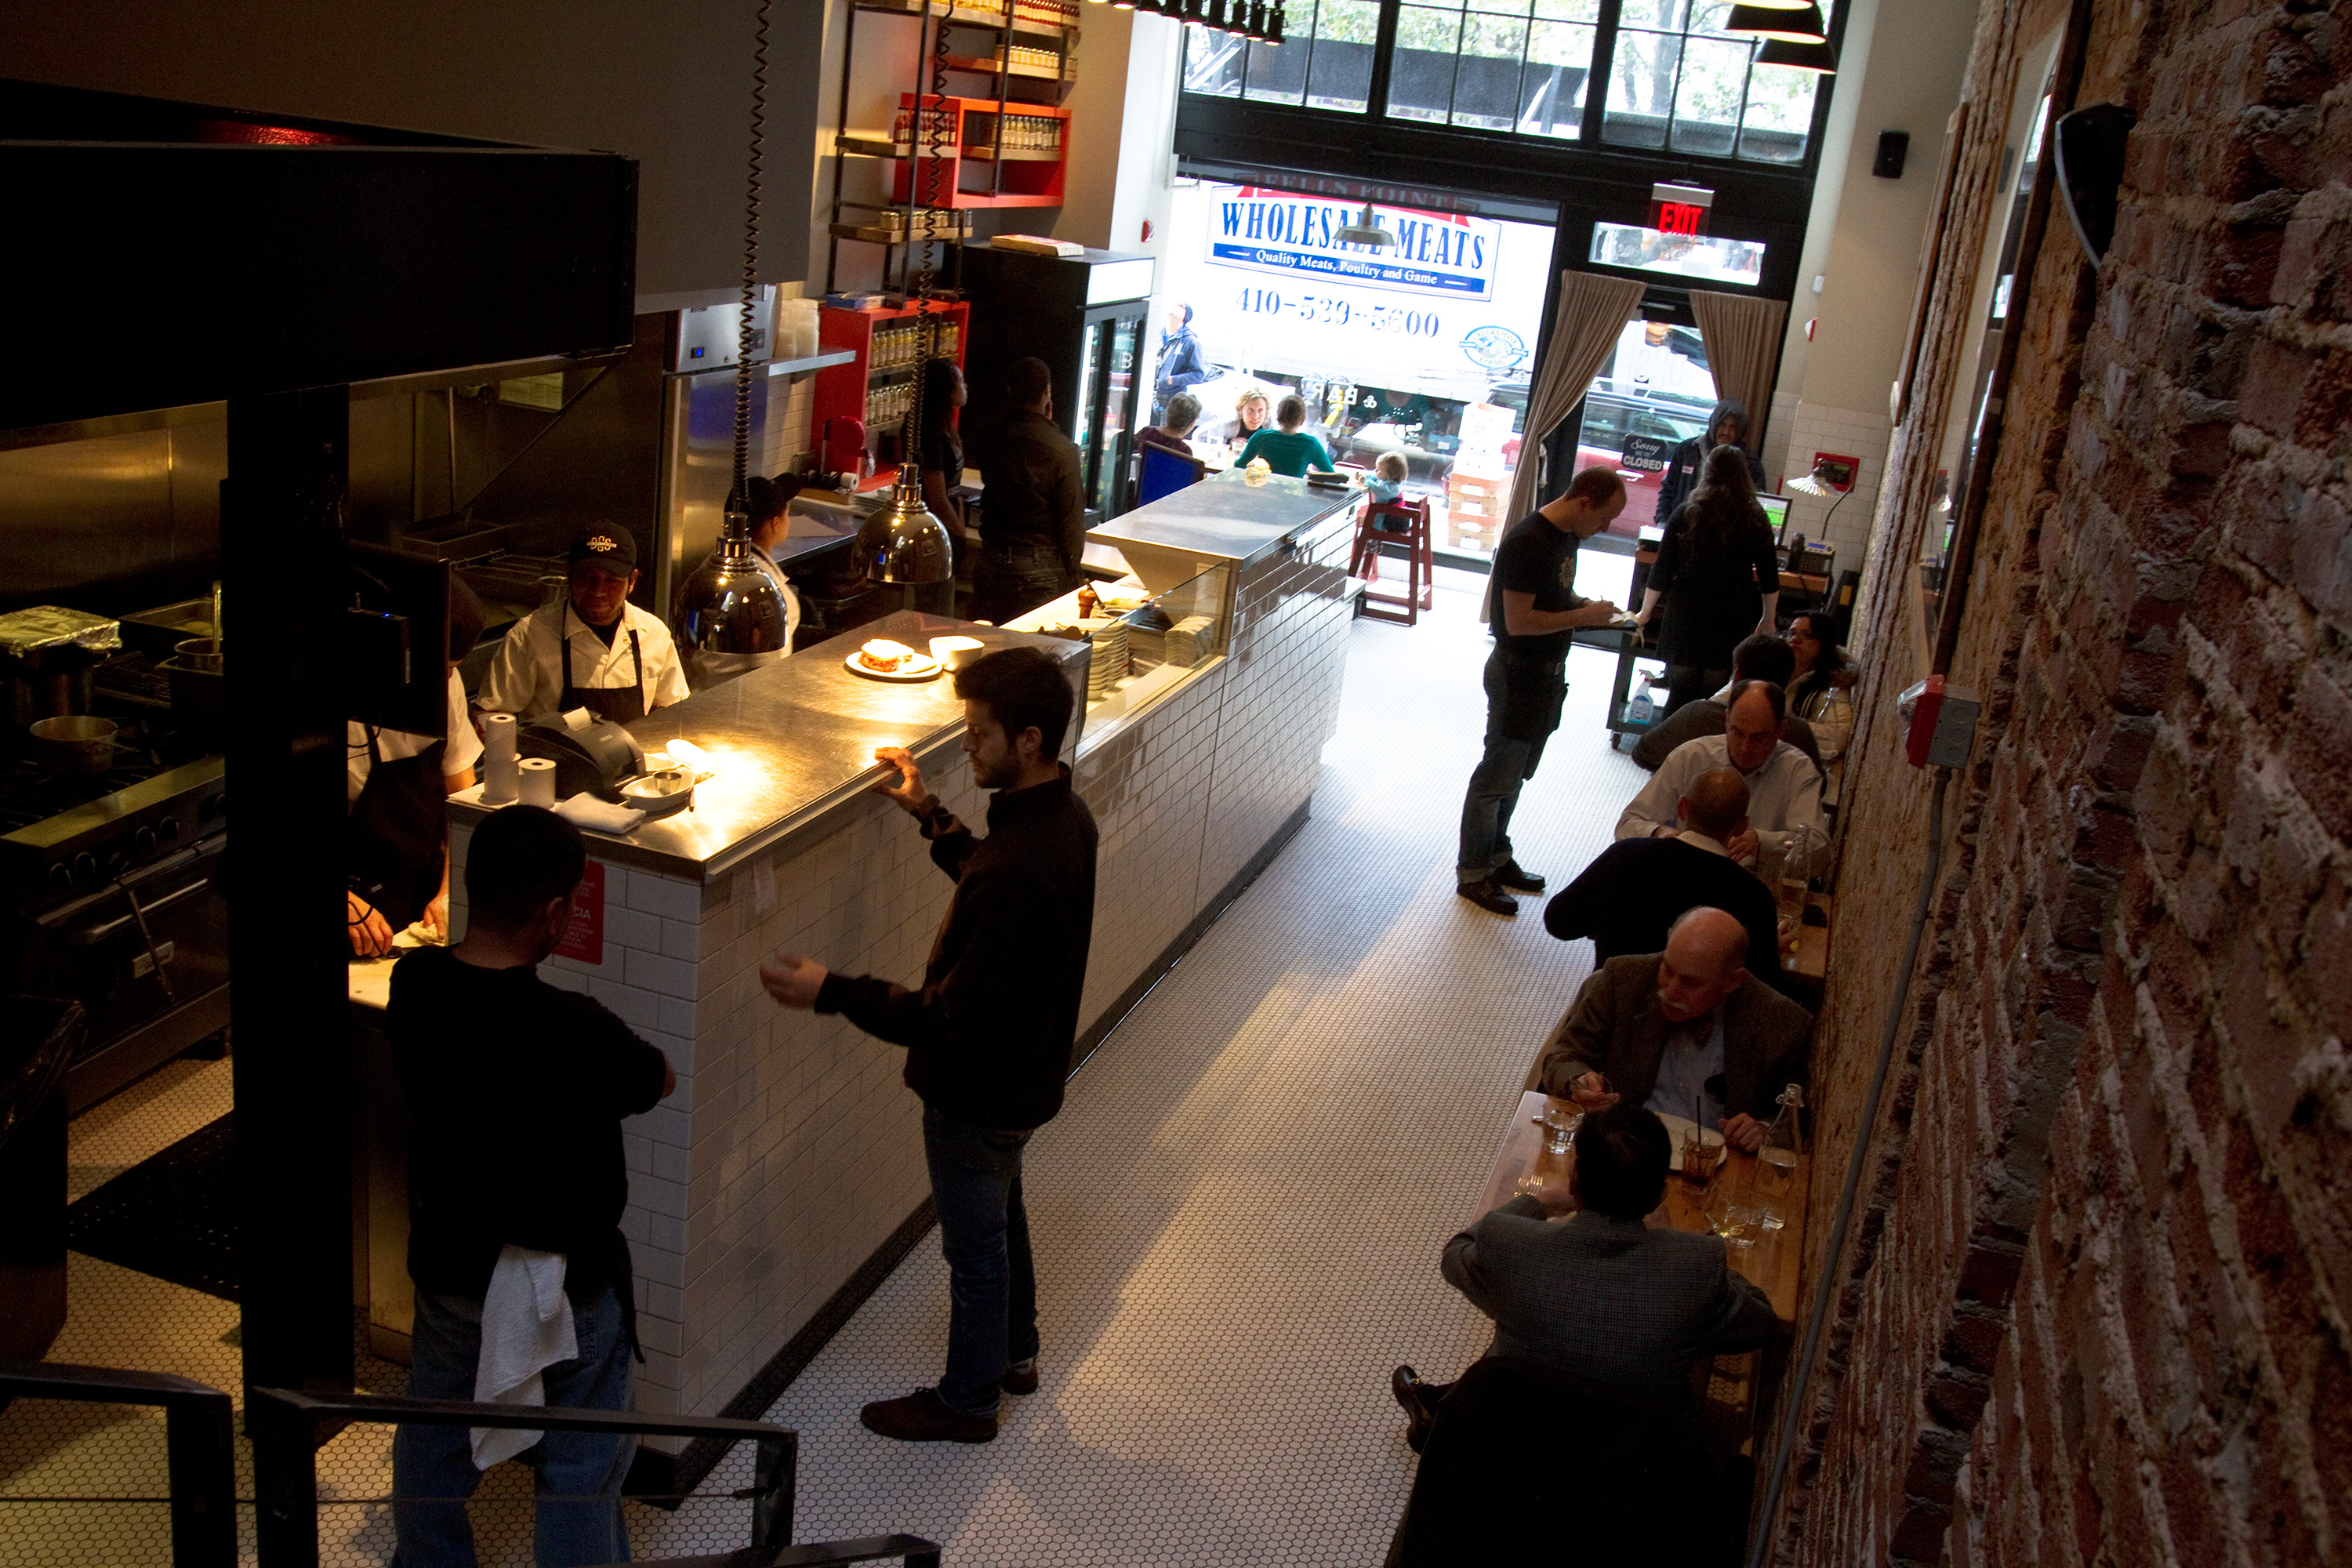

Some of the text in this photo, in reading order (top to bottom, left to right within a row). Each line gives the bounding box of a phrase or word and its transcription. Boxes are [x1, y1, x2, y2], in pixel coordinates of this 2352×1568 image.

[1658, 202, 1703, 237] EXIT
[1394, 218, 1485, 269] MEATS
[1256, 249, 1438, 285] Quality Meats, Poultry and Game
[1236, 287, 1439, 338] 410-539-5600
[1623, 456, 1662, 470] CLOSED
[1631, 438, 1661, 456] Sorry
